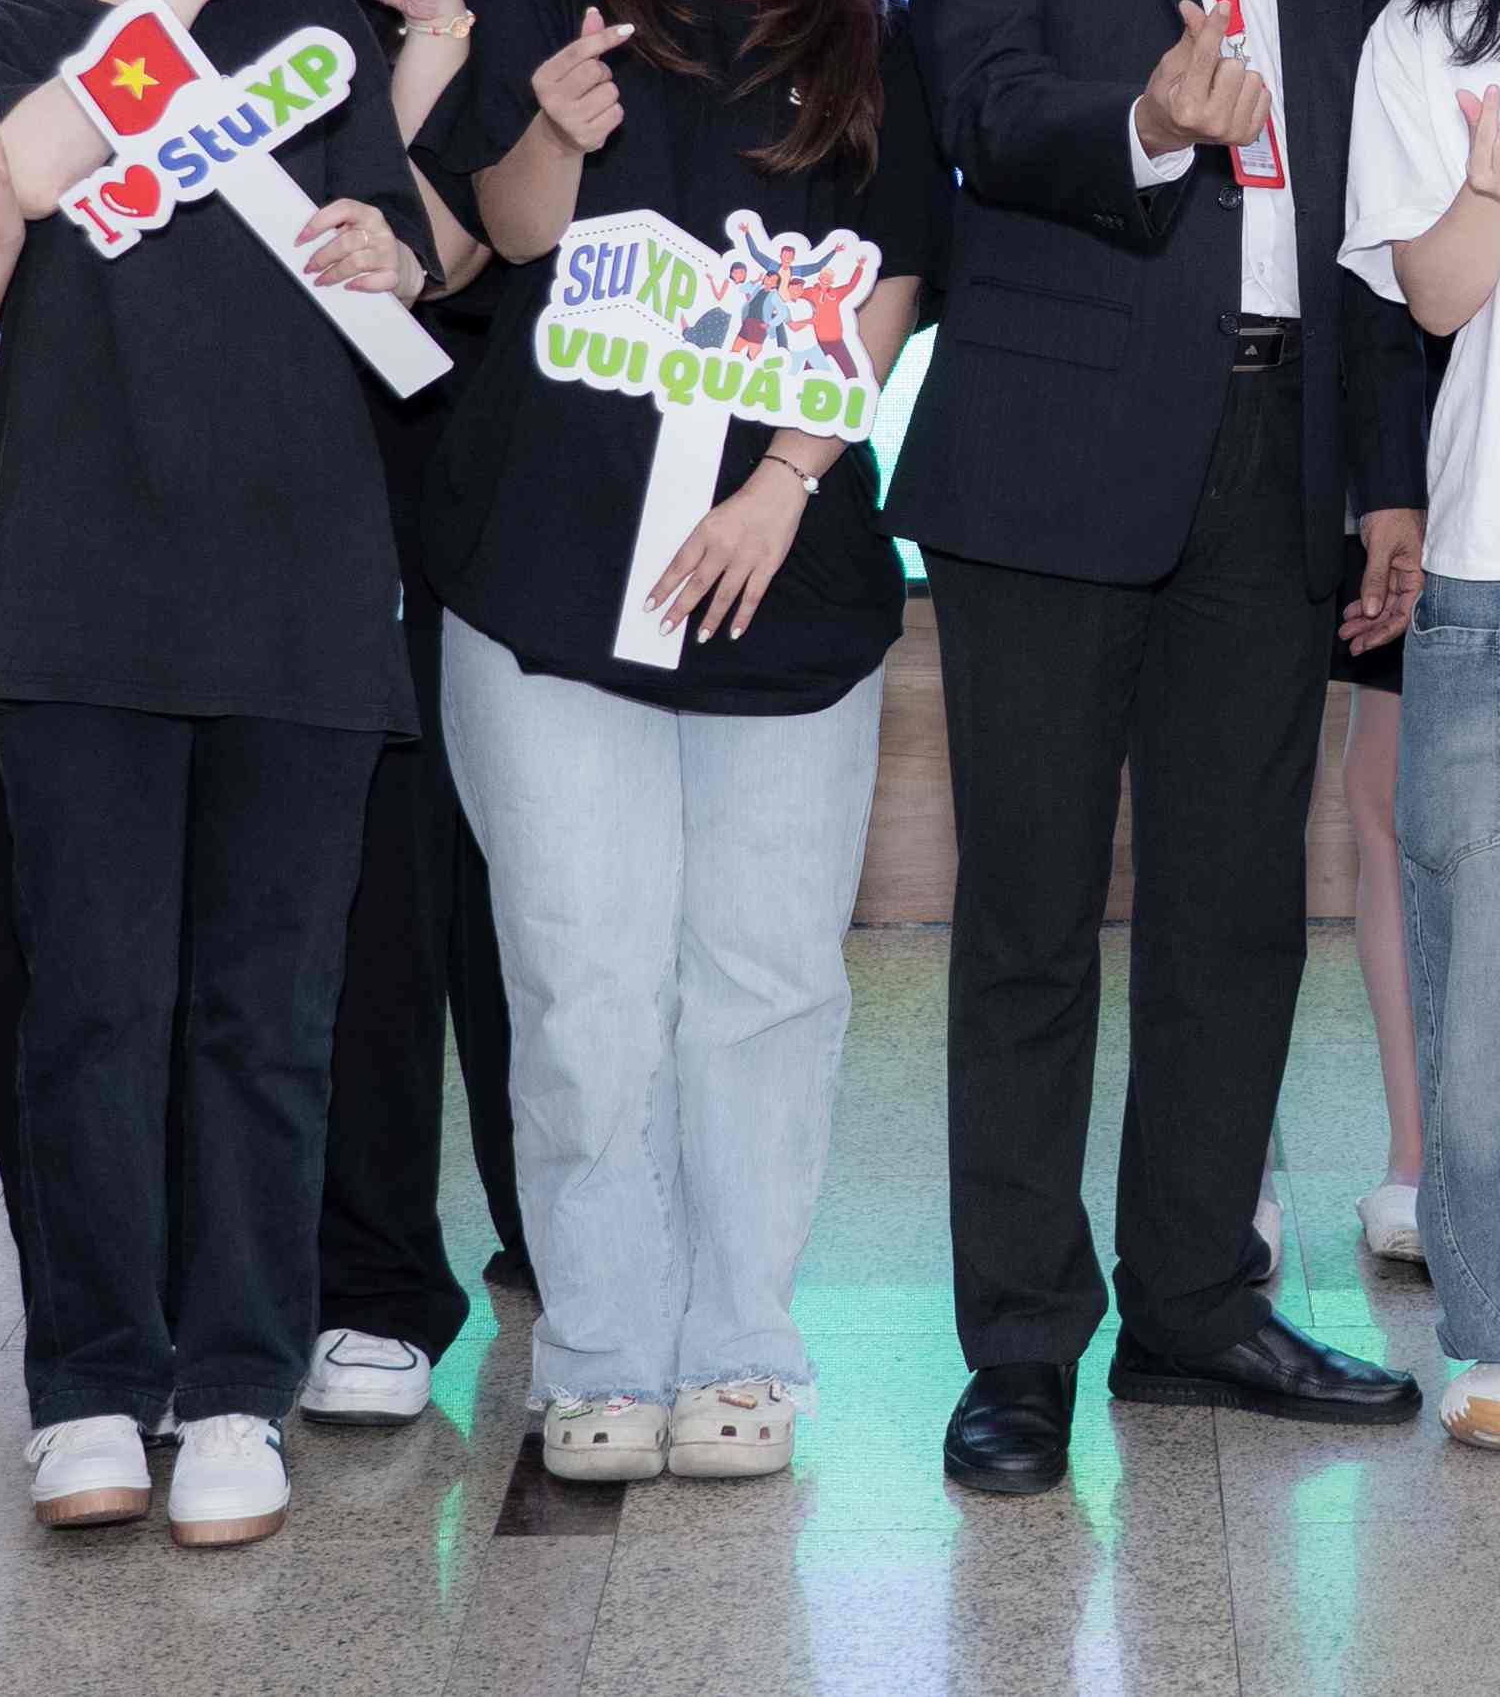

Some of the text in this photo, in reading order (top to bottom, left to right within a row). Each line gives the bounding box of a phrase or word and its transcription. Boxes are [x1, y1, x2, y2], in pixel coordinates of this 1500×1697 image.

[73, 44, 338, 245] I StuXP
[547, 323, 867, 429] VUI QUÁ ĐI
